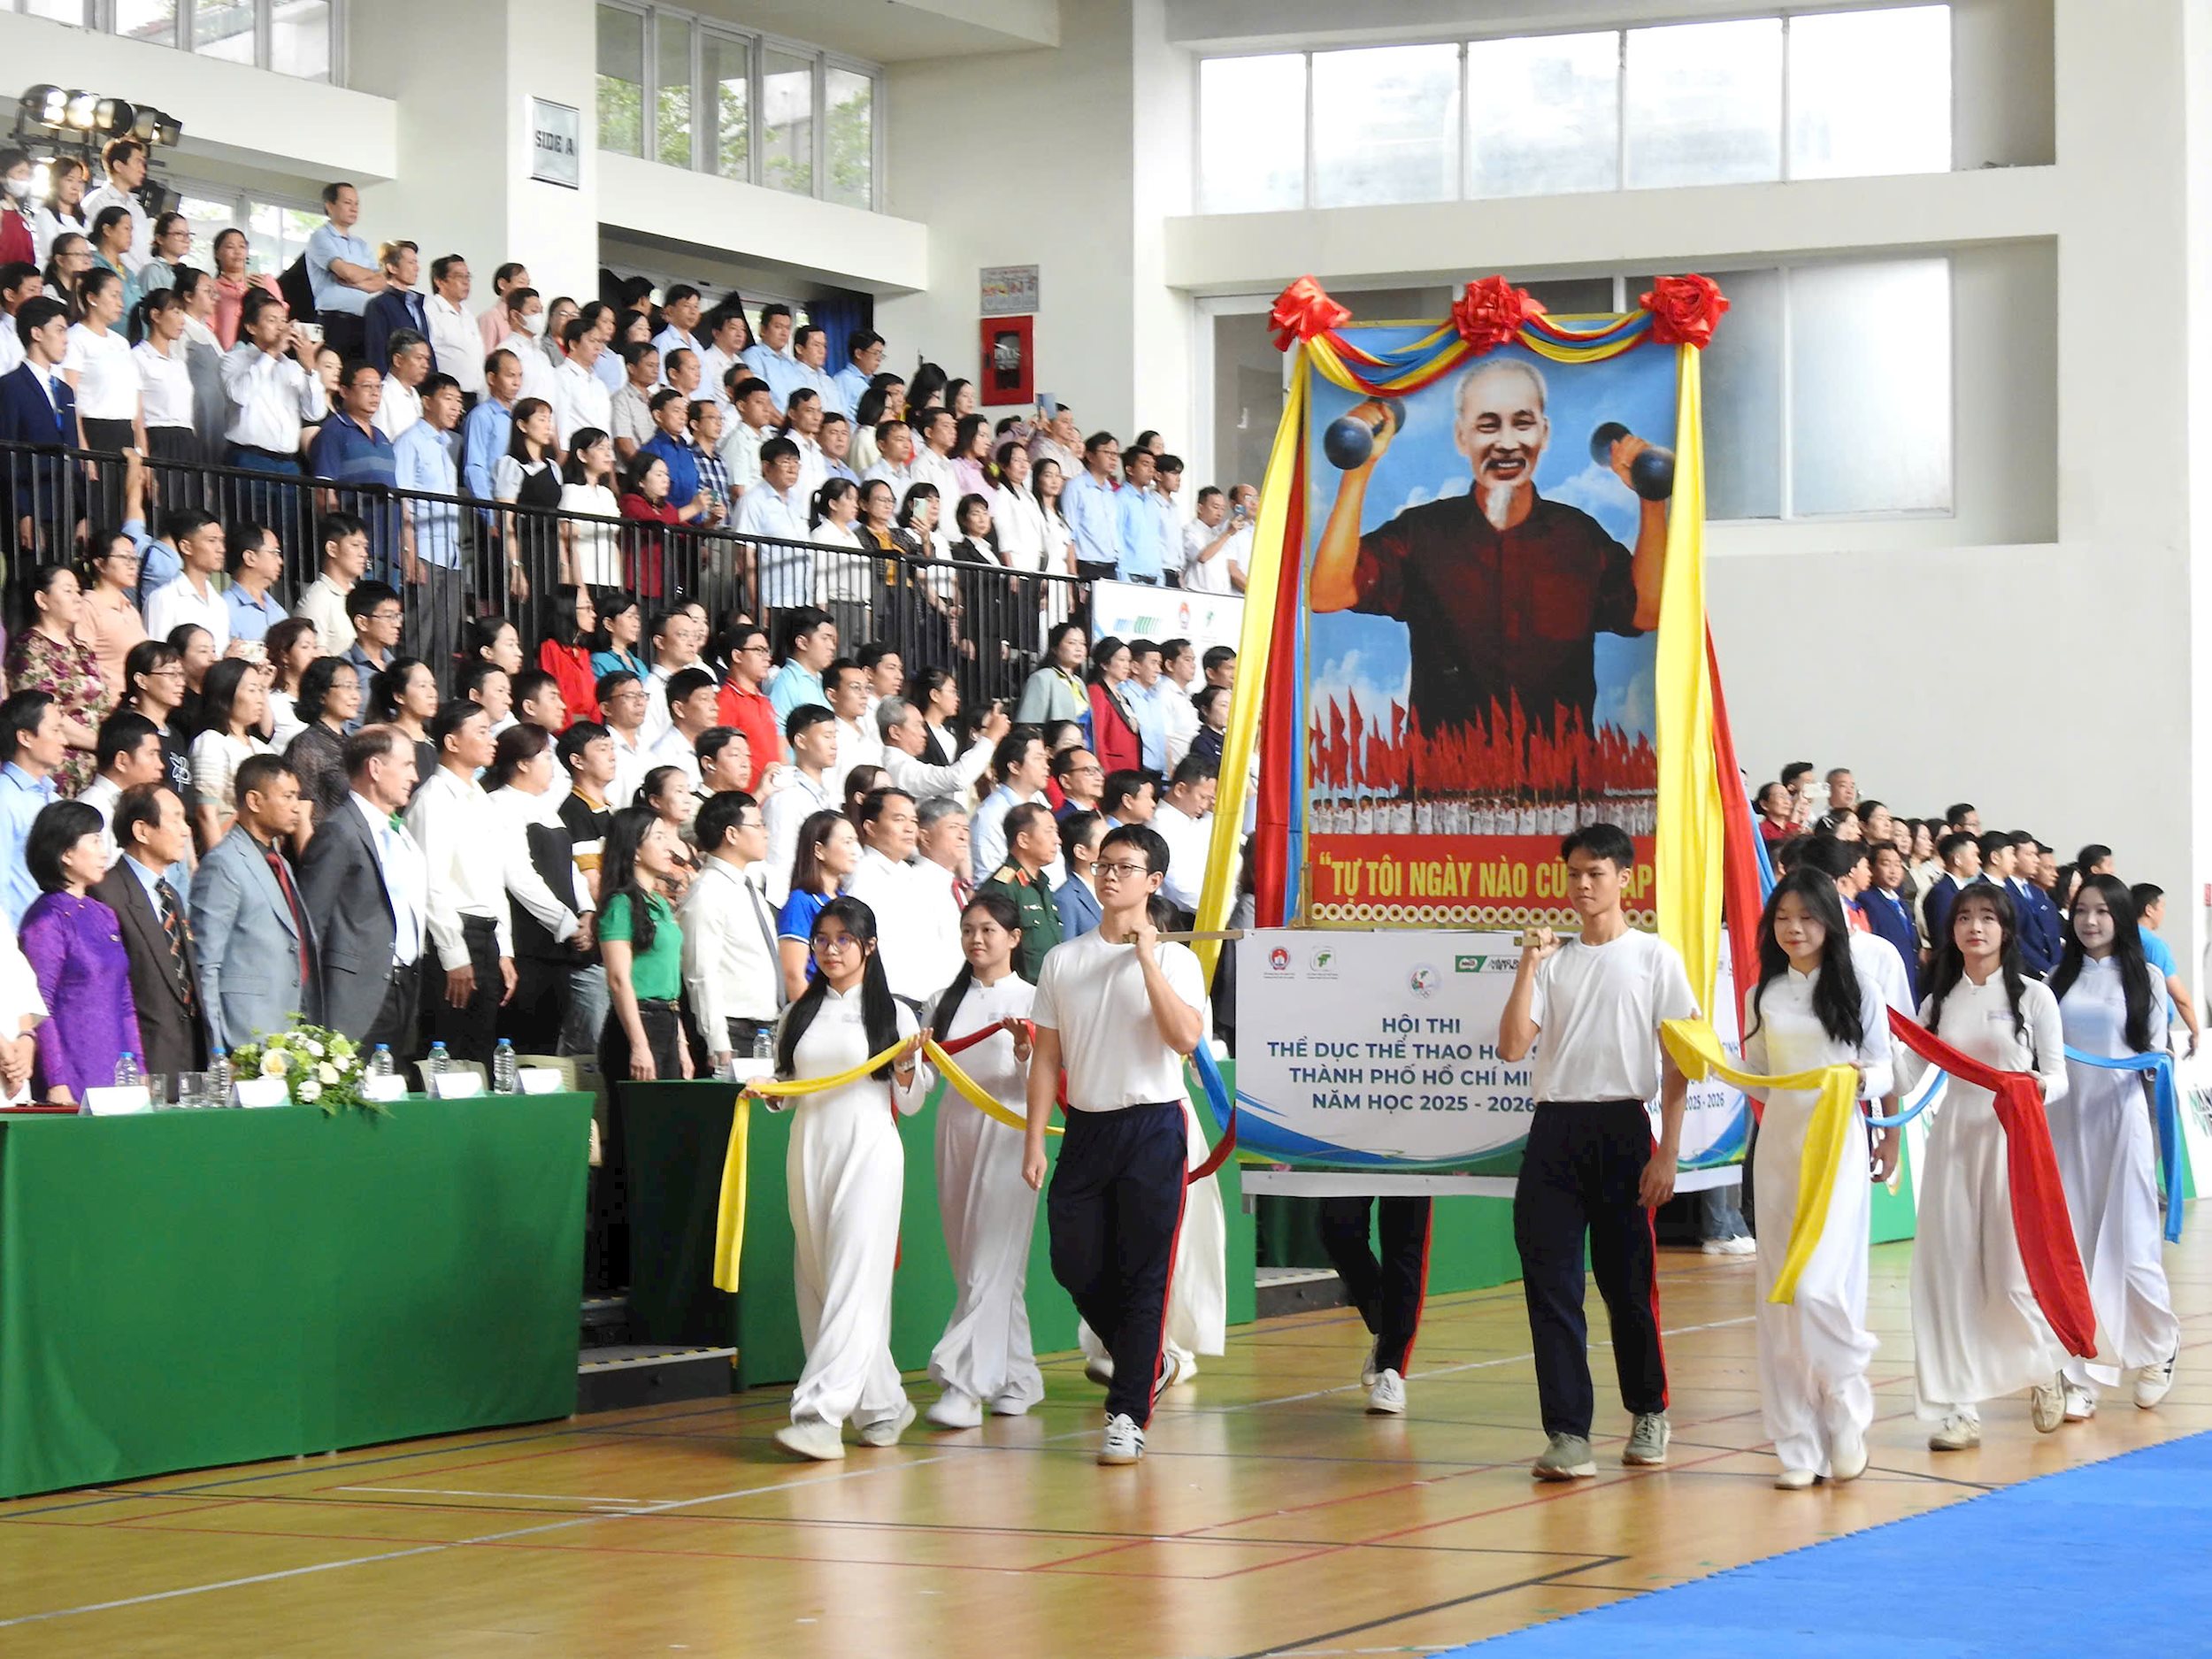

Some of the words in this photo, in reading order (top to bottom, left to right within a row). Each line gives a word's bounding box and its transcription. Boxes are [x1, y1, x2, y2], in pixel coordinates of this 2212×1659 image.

[534, 130, 562, 153] SIDE
[565, 137, 575, 157] A
[1365, 854, 1402, 896] TÔI
[1409, 854, 1472, 897] NGÀY
[1479, 855, 1529, 898] NÀO
[1535, 856, 1569, 898] CŨ
[1382, 1013, 1420, 1038] HỘI
[1426, 1018, 1460, 1034] THI
[1315, 1042, 1360, 1063] DỤC
[1413, 1044, 1472, 1060] THAO
[1289, 1064, 1363, 1084] THÀNH
[1371, 1064, 1417, 1085] PHỐ
[1423, 1064, 1455, 1086] HỒ
[1461, 1066, 1497, 1087] CHÍ
[1312, 1089, 1361, 1110] NĂM
[1368, 1094, 1414, 1115] HỌC
[1419, 1094, 1469, 1111] 2025
[1487, 1096, 1536, 1113] 2026
